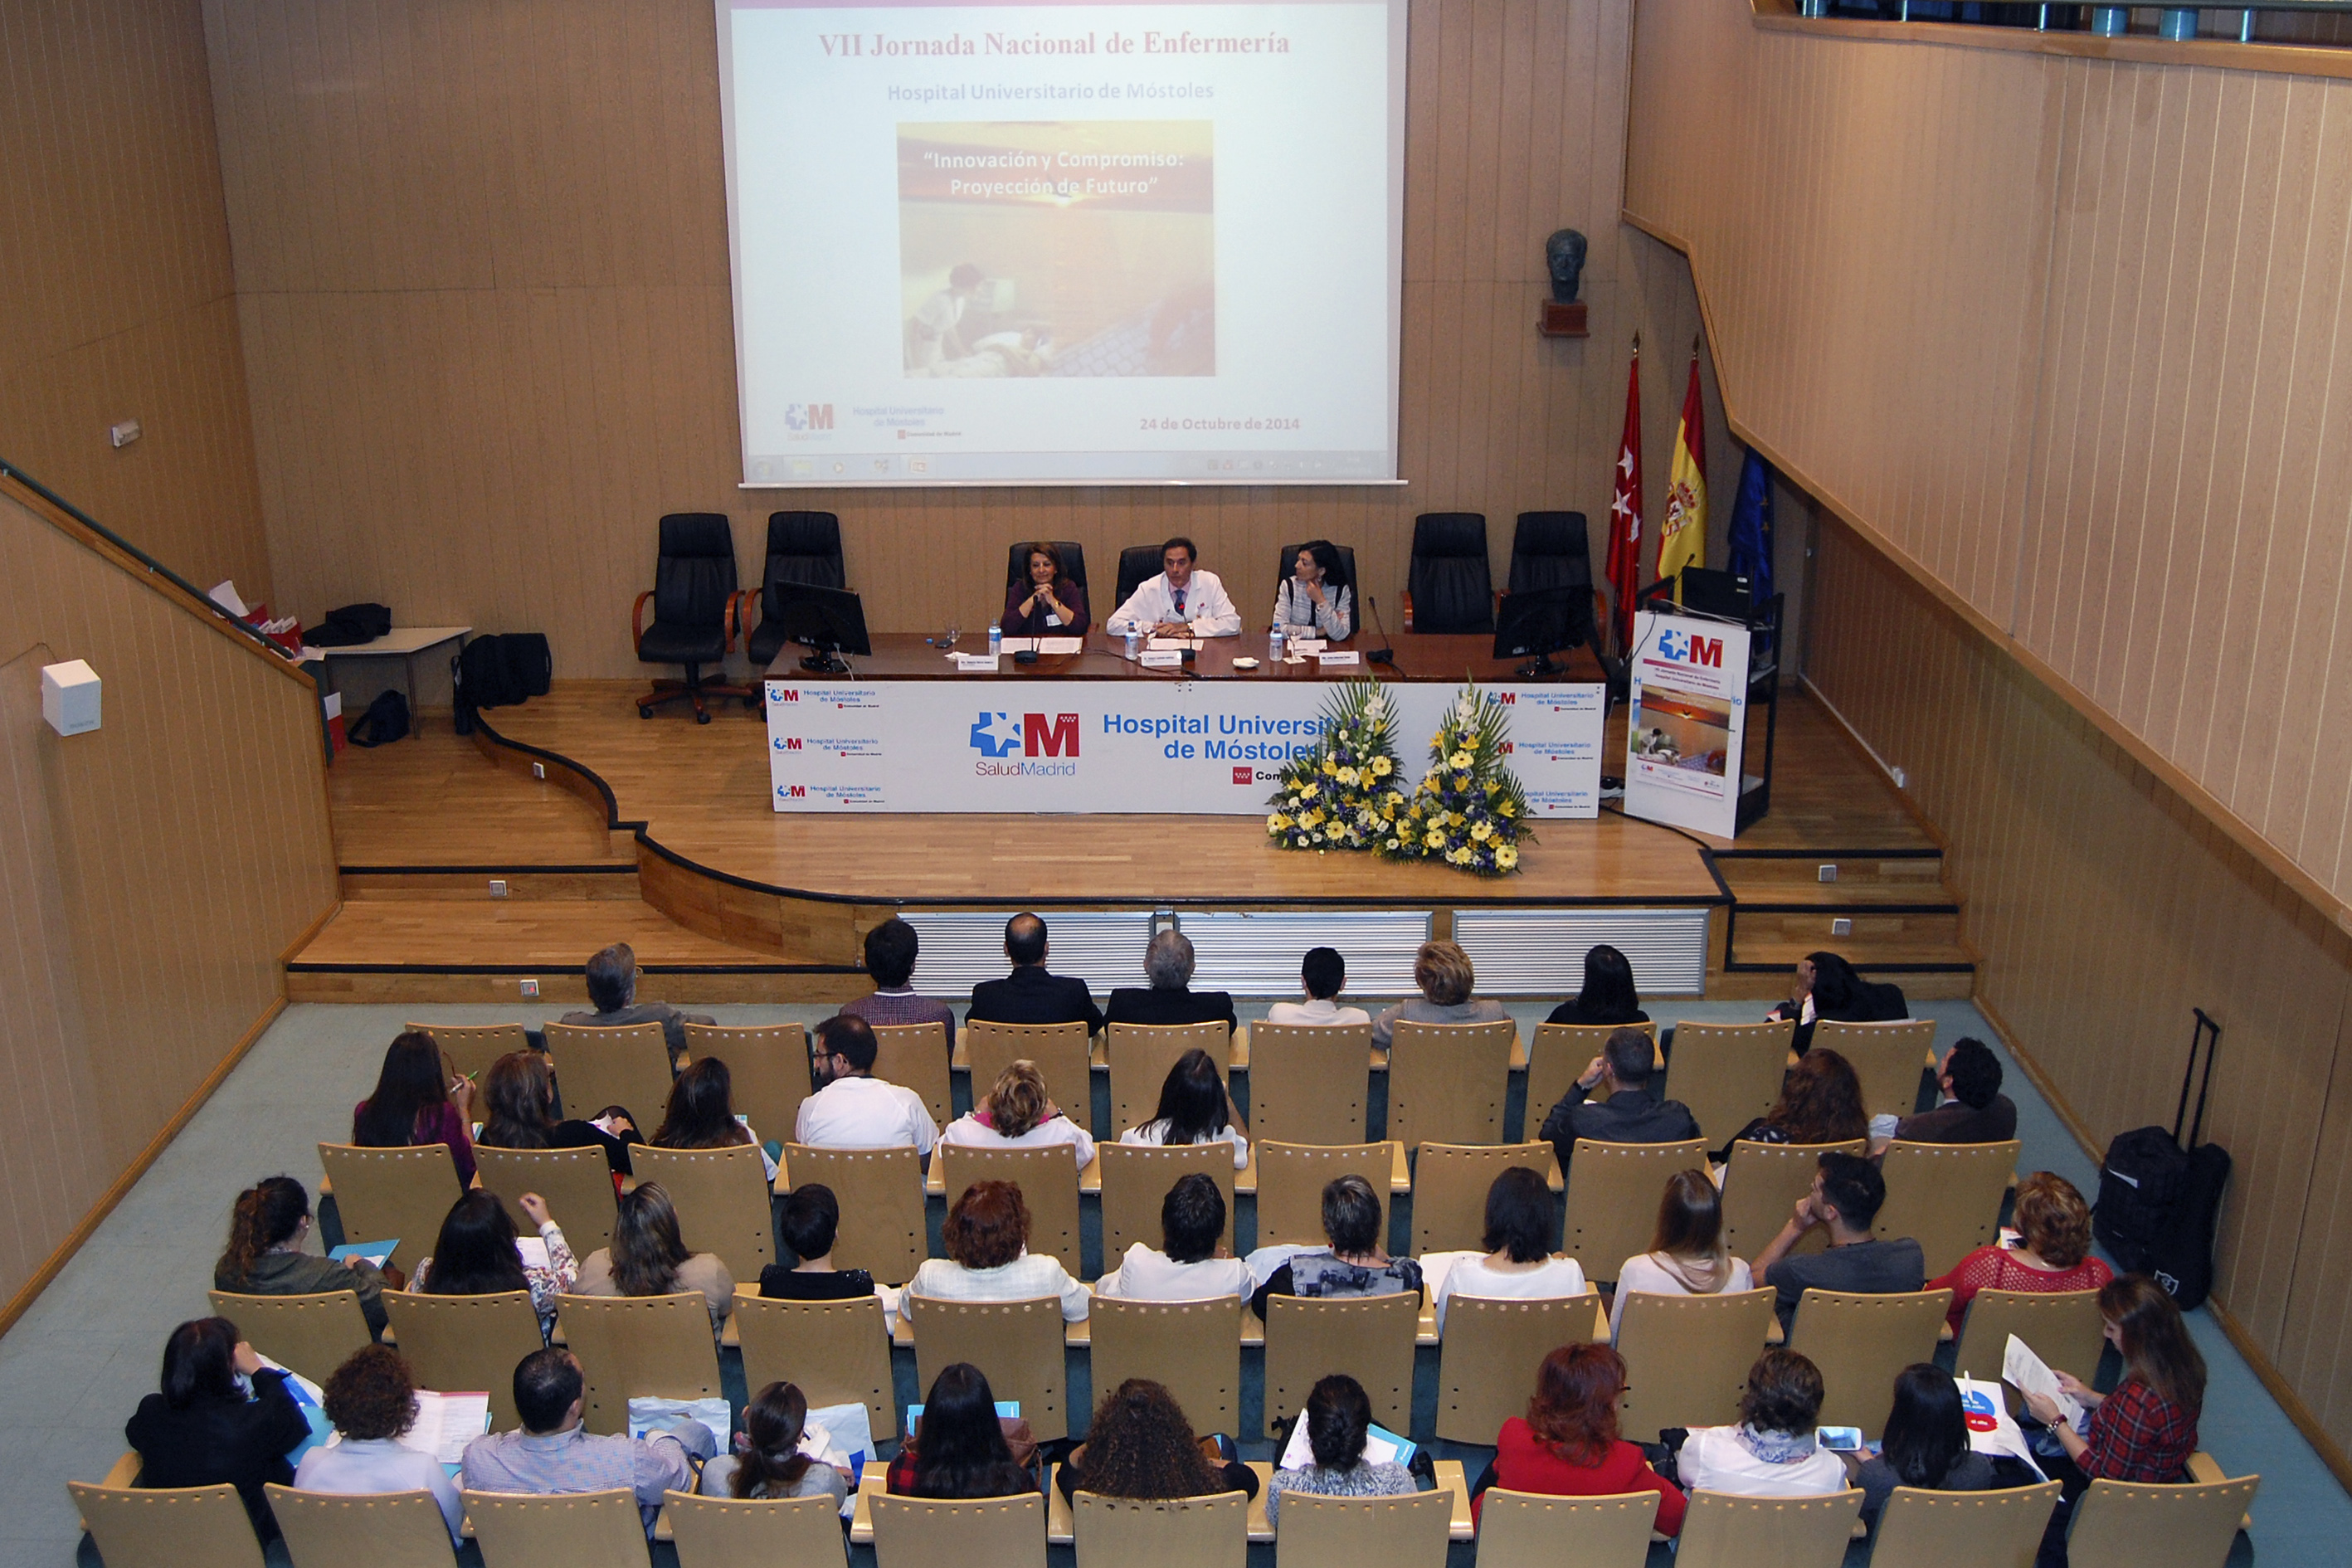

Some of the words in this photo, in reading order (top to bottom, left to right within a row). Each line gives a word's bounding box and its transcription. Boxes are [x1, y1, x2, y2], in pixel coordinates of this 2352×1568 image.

[820, 34, 863, 57] VII
[870, 34, 975, 56] Jornada
[985, 32, 1095, 55] Nacional
[1106, 32, 1135, 54] de
[1143, 31, 1290, 54] Enfermería
[888, 85, 966, 104] Hospital
[971, 84, 1094, 101] Universitario
[1098, 83, 1121, 99] de
[1127, 82, 1214, 99] Móstoles
[1042, 155, 1051, 171] y
[1057, 150, 1184, 170] Compromiso:
[951, 179, 1054, 198] Proyección
[1057, 179, 1080, 194] de
[853, 407, 888, 416] Hospital
[889, 406, 944, 416] Universitario
[874, 417, 884, 426] de
[1140, 418, 1157, 430] 24
[1161, 417, 1178, 430] de
[1182, 417, 1241, 430] Octubre
[1244, 417, 1262, 430] de
[1265, 417, 1300, 430] 2014
[1023, 713, 1079, 757] M
[1103, 714, 1209, 738] Hospital
[1219, 714, 1332, 736] Universi
[1164, 741, 1195, 759] de
[976, 762, 1076, 777] SaludMadrid
